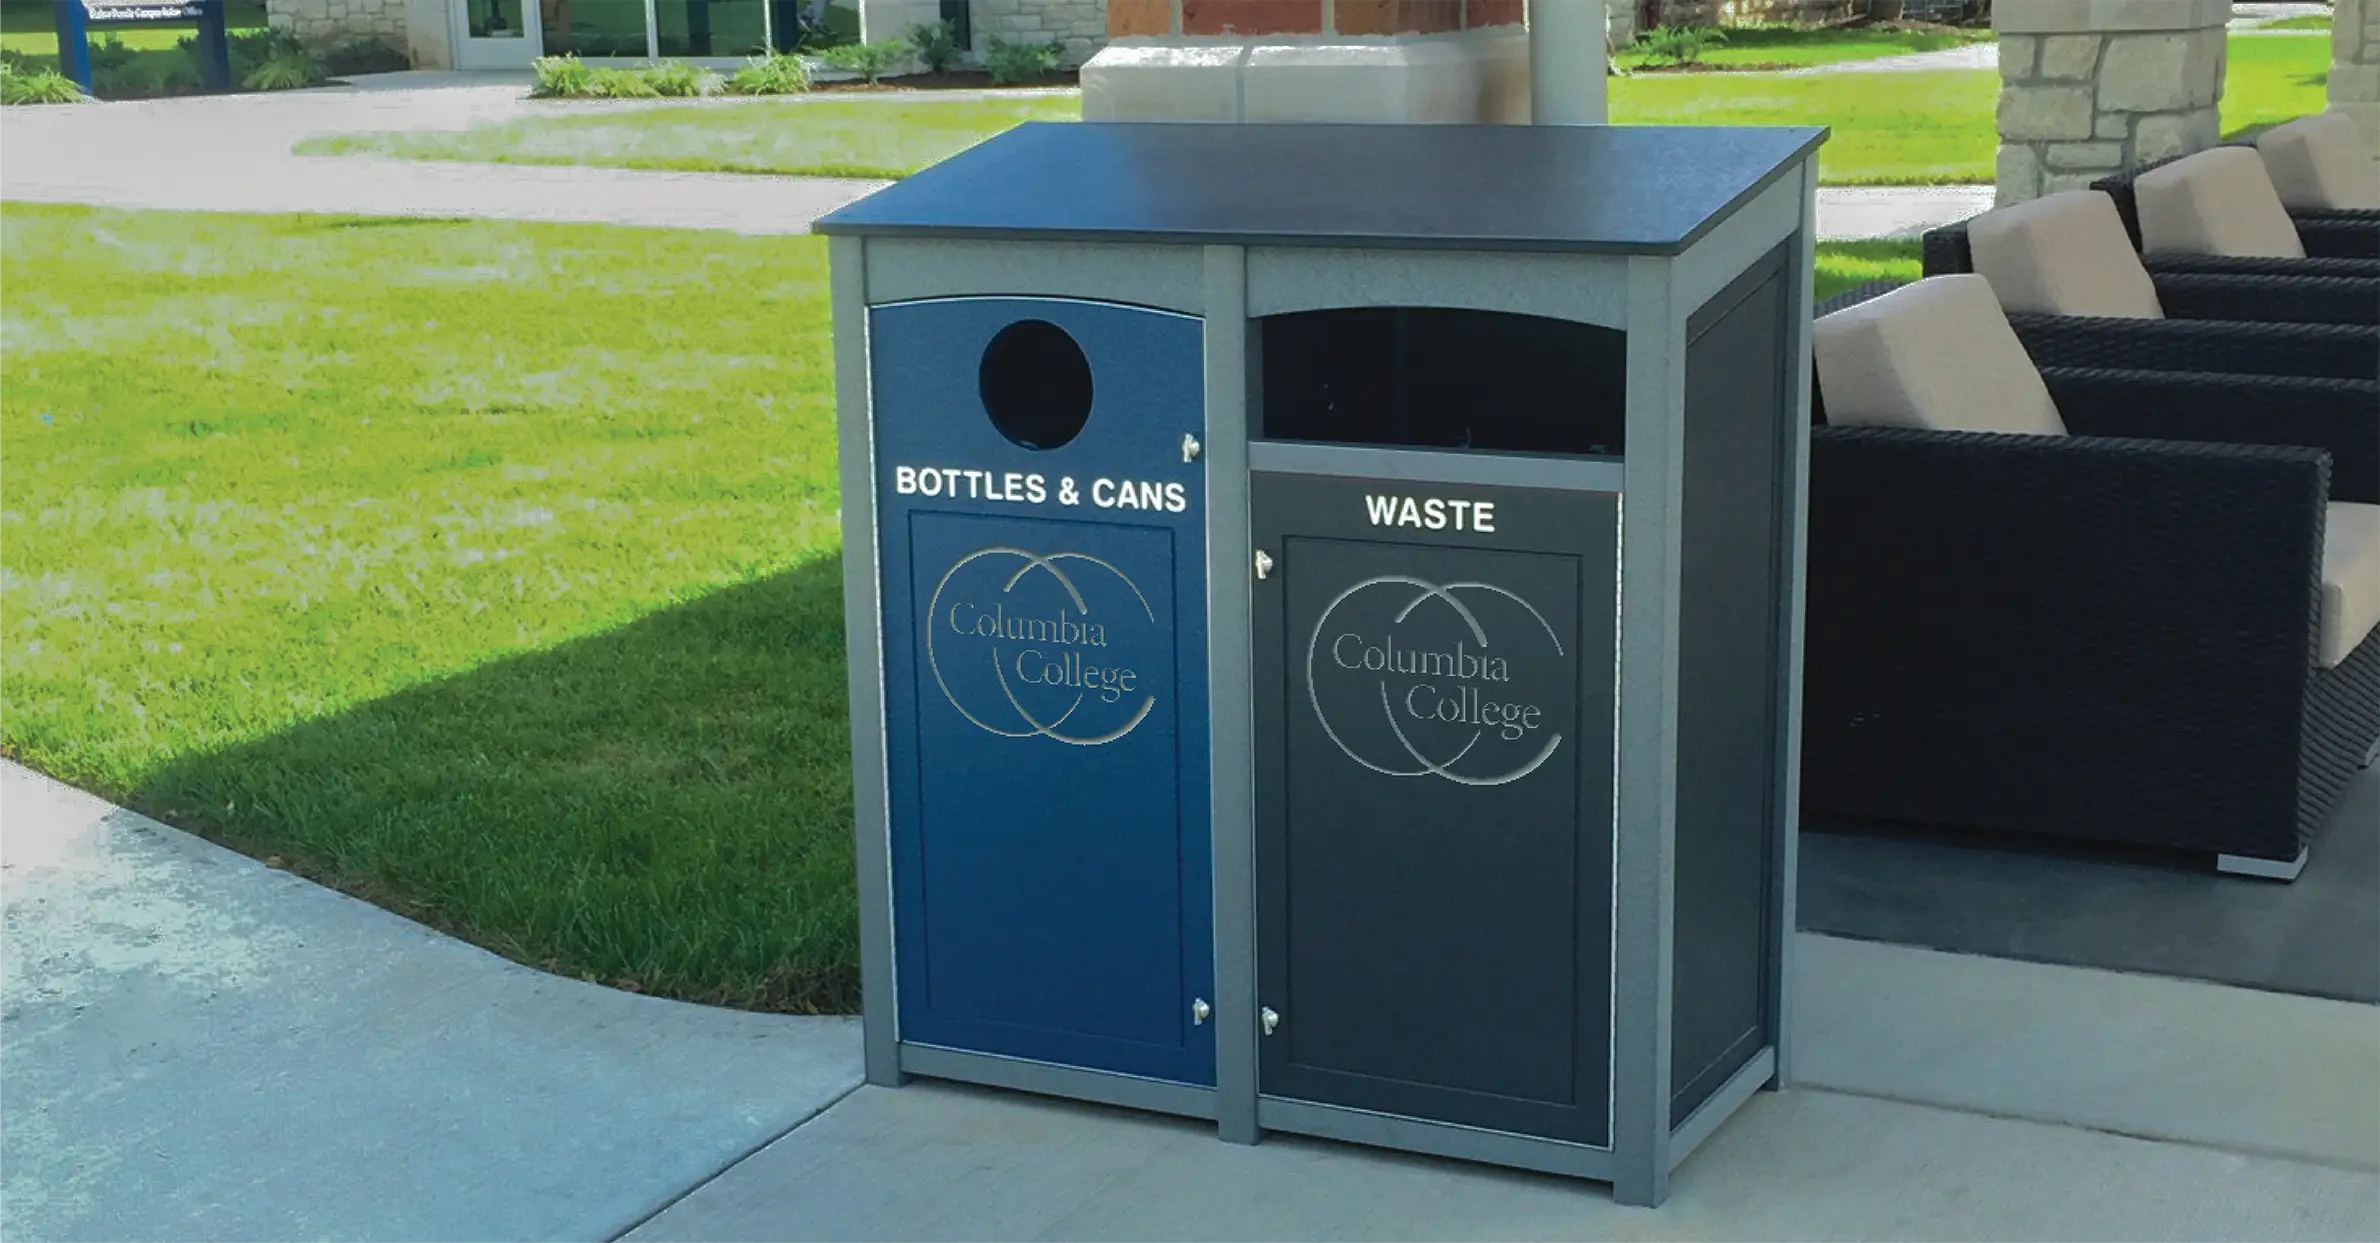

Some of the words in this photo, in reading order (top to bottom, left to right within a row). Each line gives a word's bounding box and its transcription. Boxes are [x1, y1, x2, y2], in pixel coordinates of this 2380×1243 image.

[896, 466, 1046, 503] BOTTLES
[1058, 477, 1080, 506] &
[1092, 478, 1186, 512] CANS
[1365, 495, 1496, 532] WASTE
[950, 602, 1107, 647] Columbia
[1016, 649, 1137, 703] College
[1332, 633, 1510, 682] Columbia
[1405, 684, 1542, 740] College
